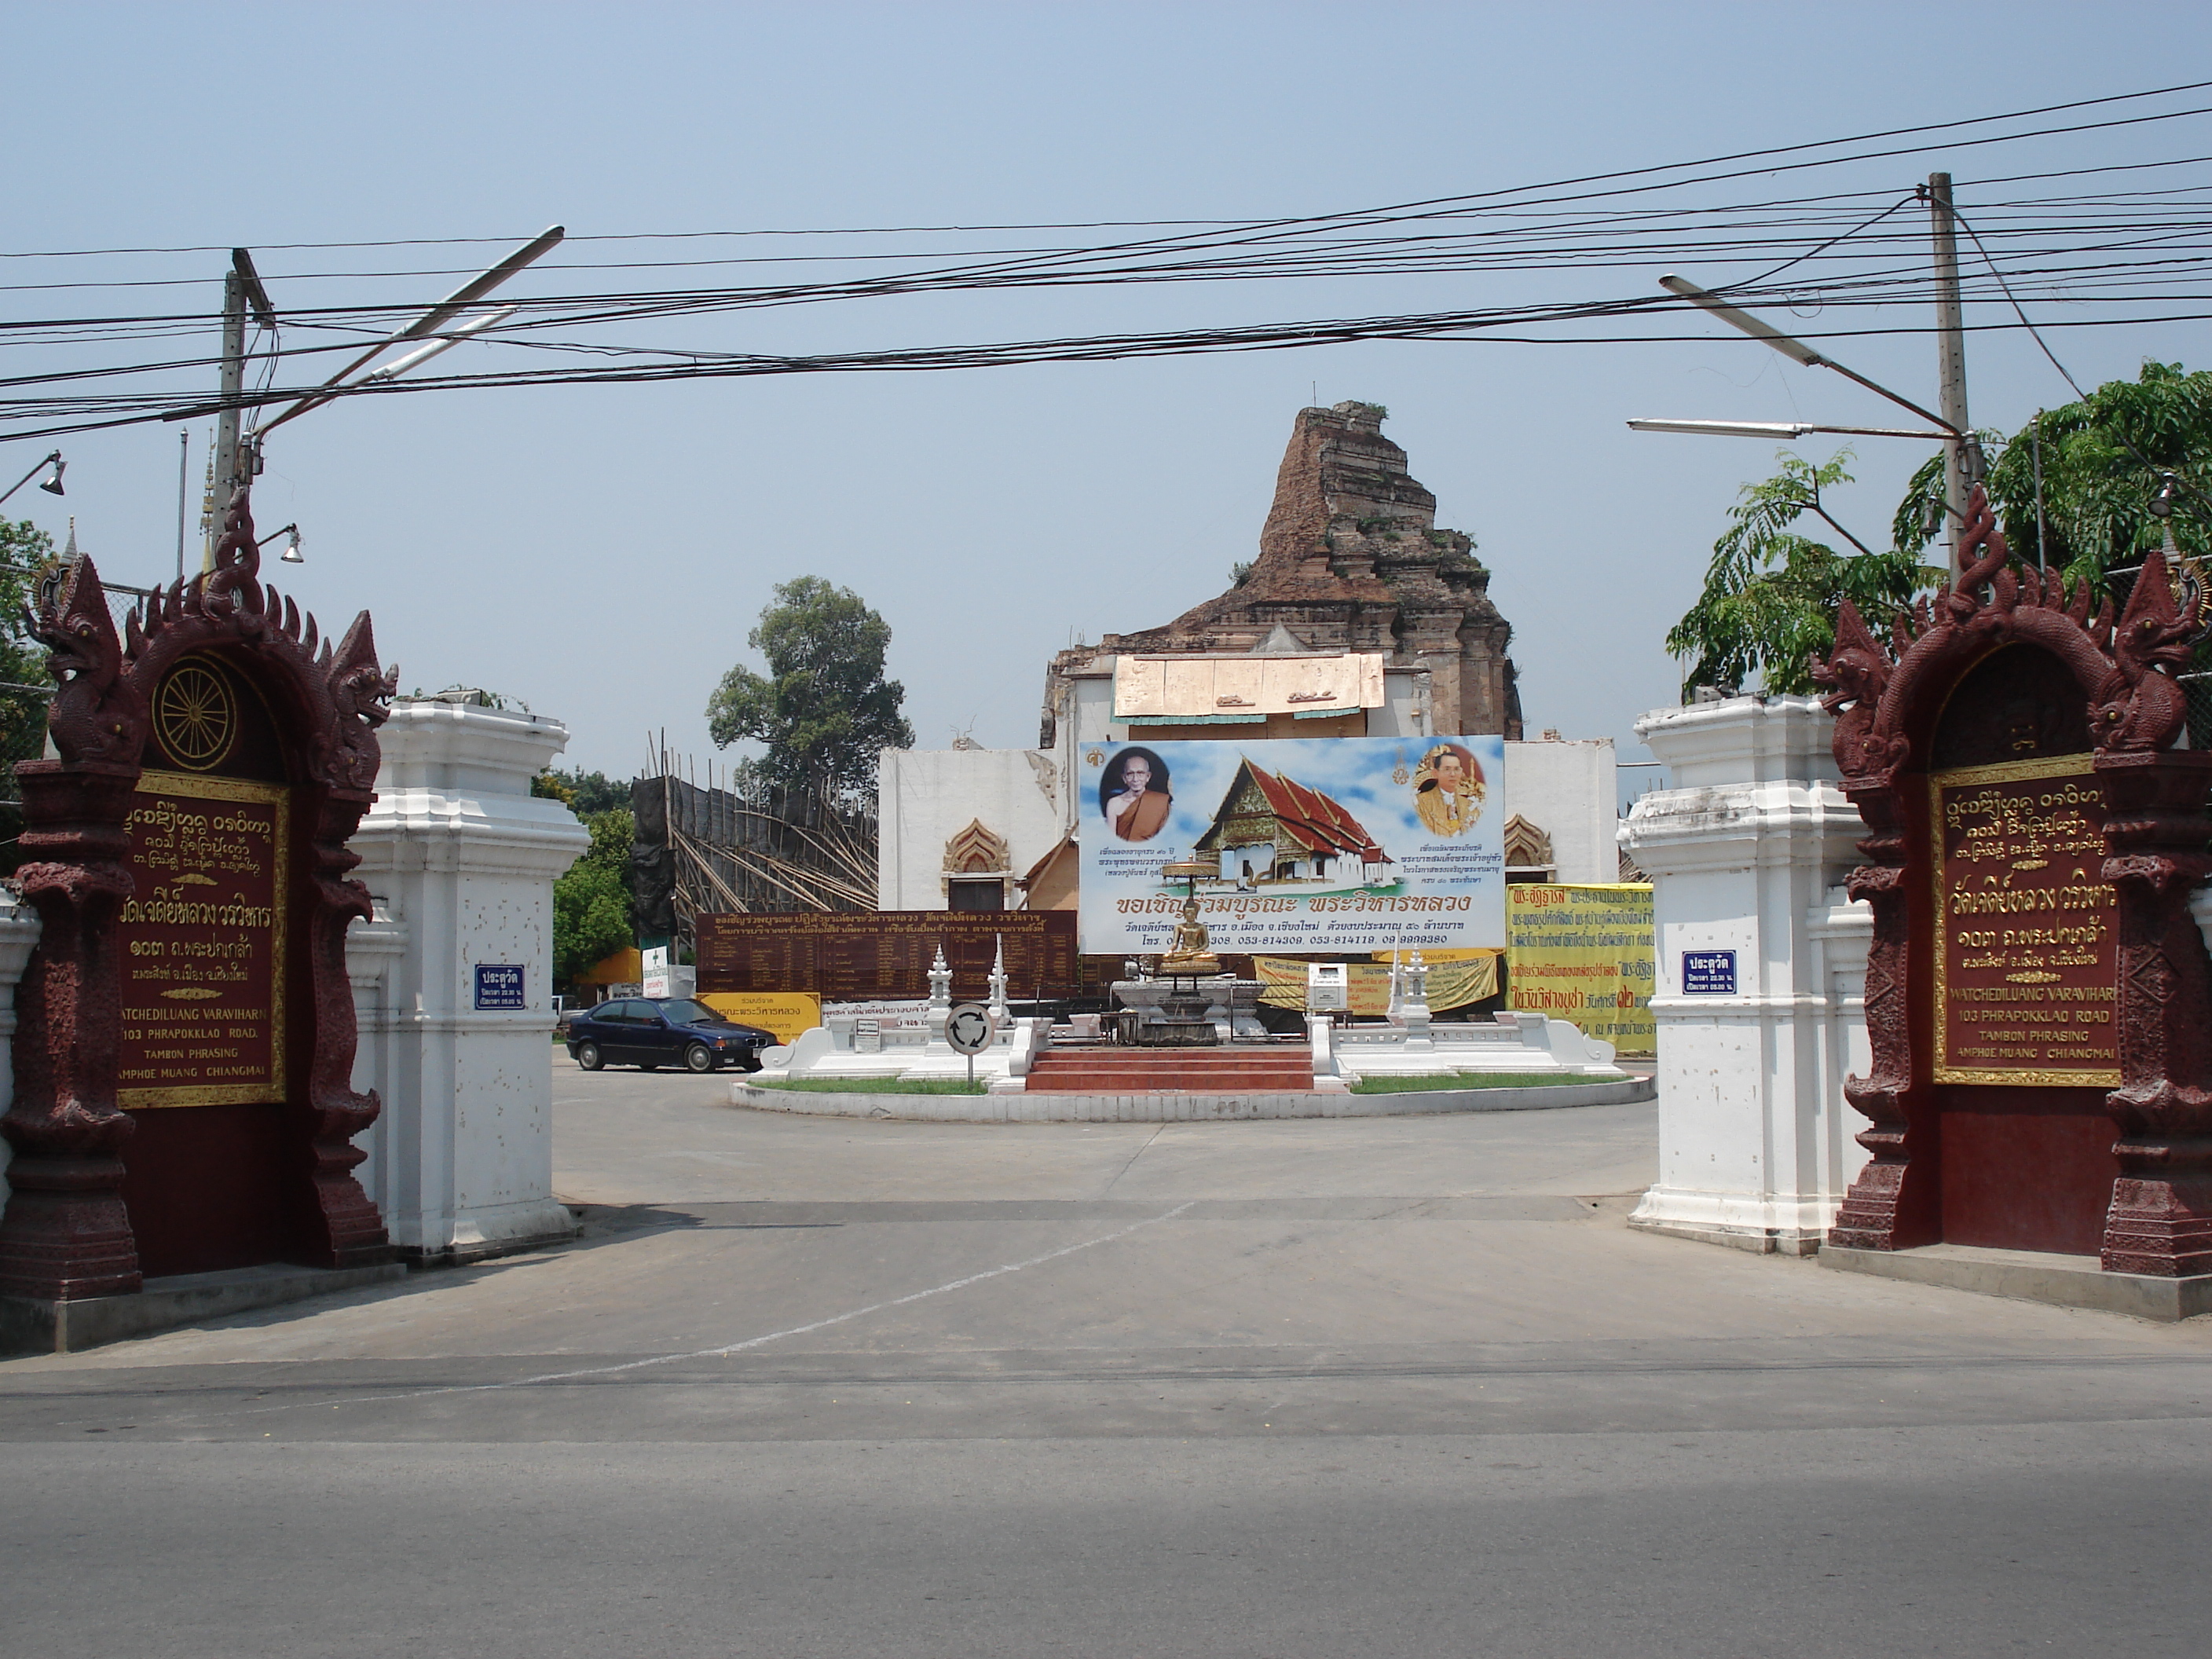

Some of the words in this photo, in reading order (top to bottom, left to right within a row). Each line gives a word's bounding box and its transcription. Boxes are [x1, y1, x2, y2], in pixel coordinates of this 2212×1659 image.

[1949, 870, 2056, 914] วัดเจดีย์หลวง
[2060, 867, 2117, 910] วรวิหาร
[1309, 891, 1472, 913] พระวิหารหลวง
[219, 892, 272, 928] วรวิหาร
[1957, 929, 1997, 947] ๑๐๓
[1690, 954, 1729, 974] ประตูวัด
[2010, 949, 2044, 968] อ.เมือง
[482, 969, 518, 988] ประตูวัด
[1950, 987, 2045, 1002] WATCHEDILUANG
[122, 1008, 199, 1020] TCHEDILUANG
[203, 1009, 266, 1020] VARAVIHARN
[1959, 1010, 1978, 1022] 103
[1982, 1010, 2068, 1023] PHRAPOKKLAO
[2075, 1010, 2109, 1023] ROAD
[123, 1030, 141, 1040] 103
[148, 1029, 220, 1039] PHRAPOKKLAO
[1979, 1031, 2026, 1042] TAMBON
[2029, 1031, 2089, 1042] PHRASING
[144, 1049, 184, 1060] TAMBON
[189, 1048, 238, 1059] PHRASING
[1957, 1047, 1997, 1058] AMPHOE
[1999, 1048, 2038, 1059] MUANG
[2047, 1048, 2115, 1059] CHIANGMAI
[161, 1068, 198, 1078] MUANG
[207, 1066, 265, 1077] CHIANGMAI
